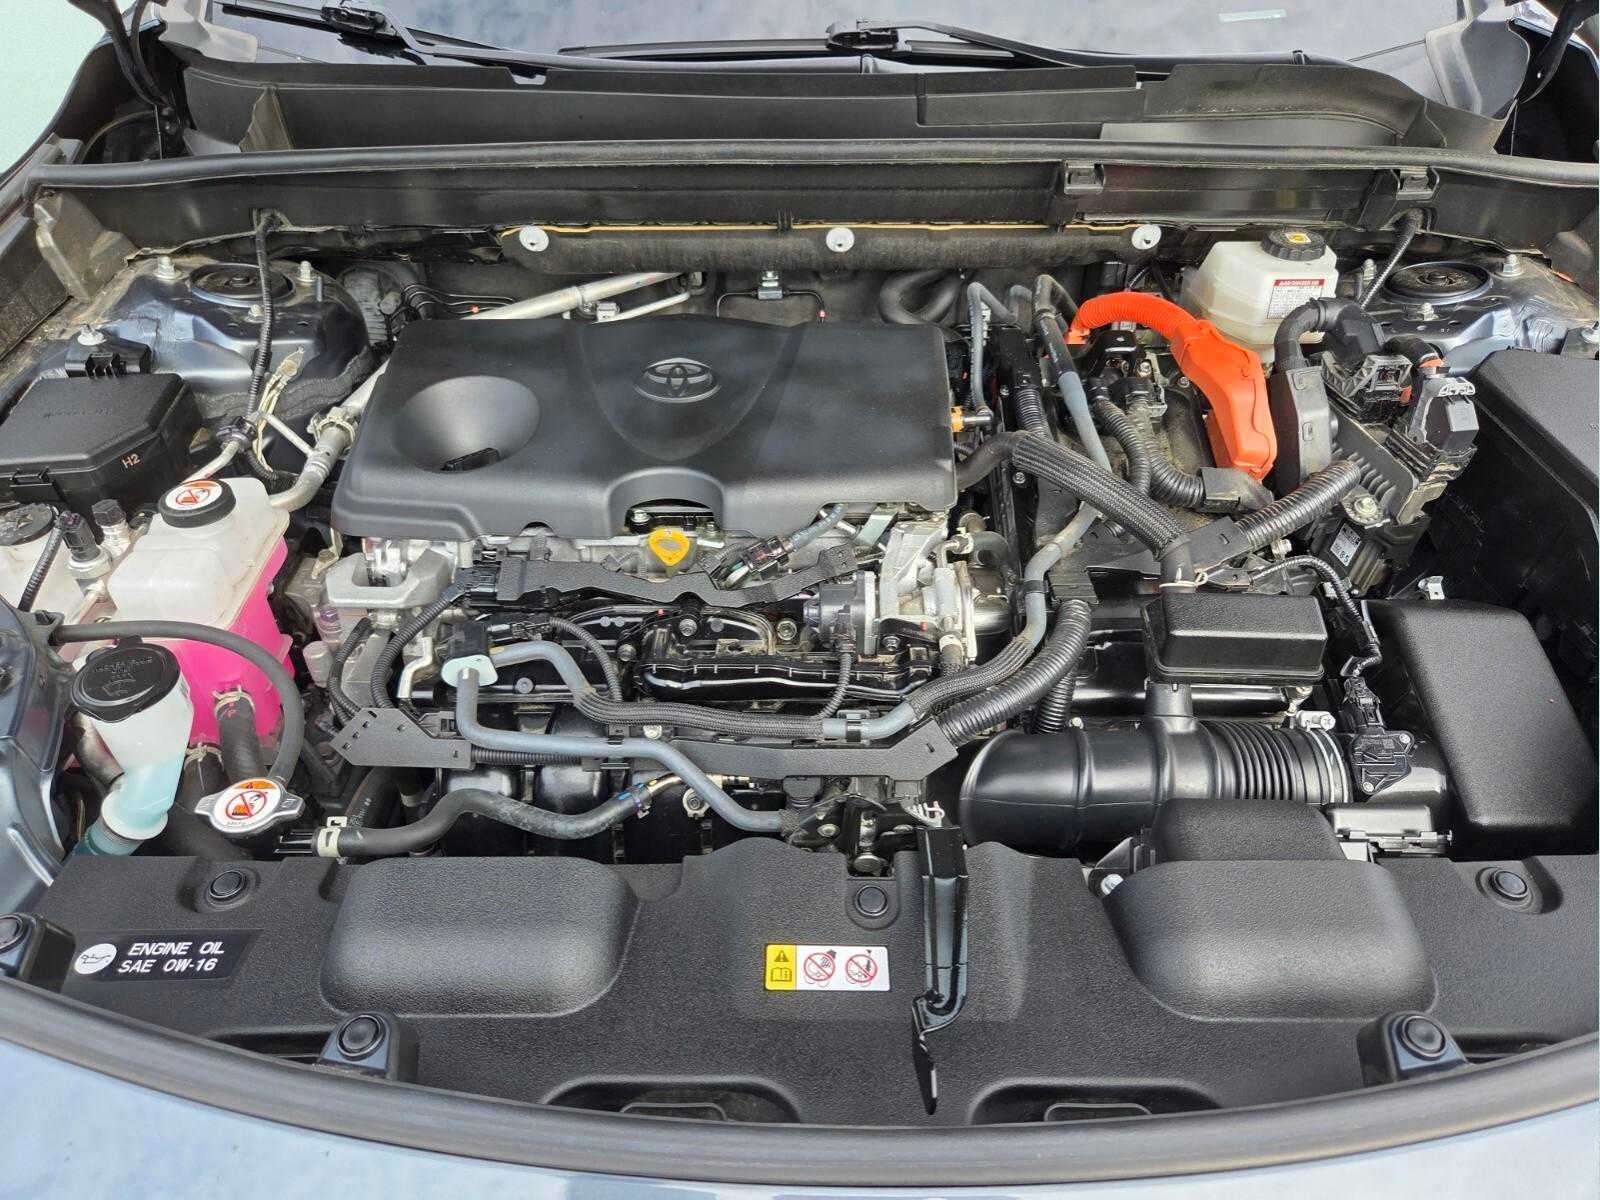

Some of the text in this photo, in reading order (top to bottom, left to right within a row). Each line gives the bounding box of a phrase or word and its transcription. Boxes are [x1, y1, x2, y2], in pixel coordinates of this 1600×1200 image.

[122, 453, 141, 468] H2
[128, 941, 225, 956] ENGINE OIL
[117, 958, 218, 973] SAE 0W-16
